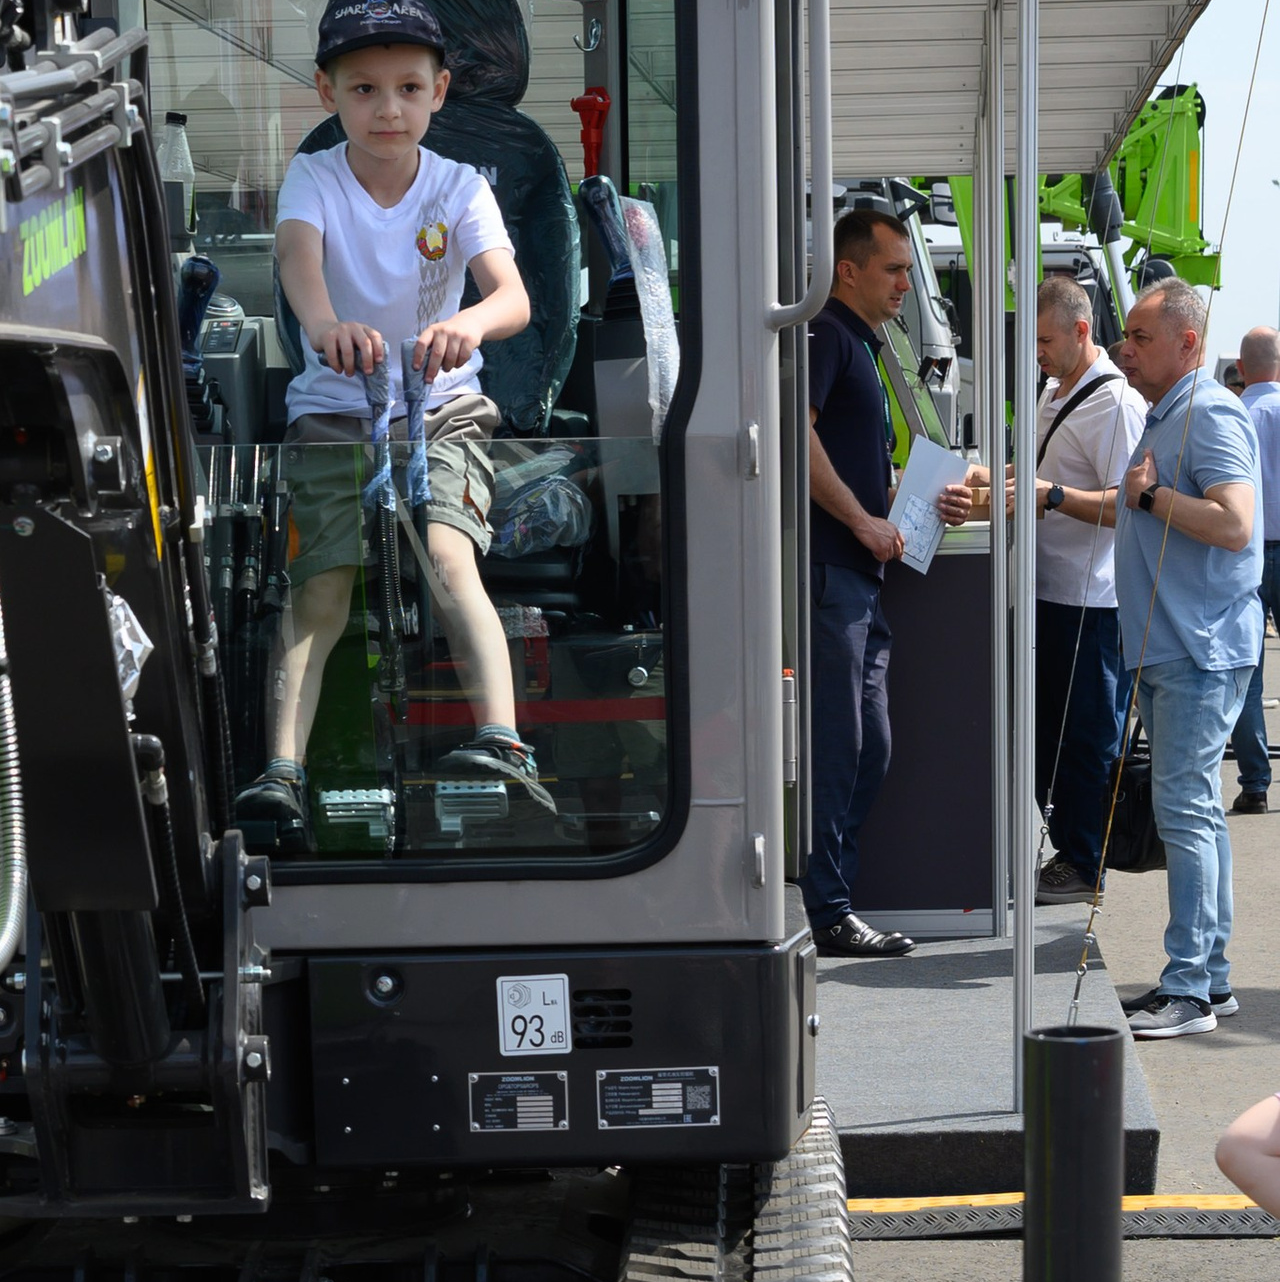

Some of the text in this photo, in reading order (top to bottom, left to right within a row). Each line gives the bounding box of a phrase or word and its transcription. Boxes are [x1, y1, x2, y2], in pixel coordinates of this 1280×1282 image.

[19, 186, 86, 297] ZOOMLION
[511, 1014, 565, 1048] 93 dB
